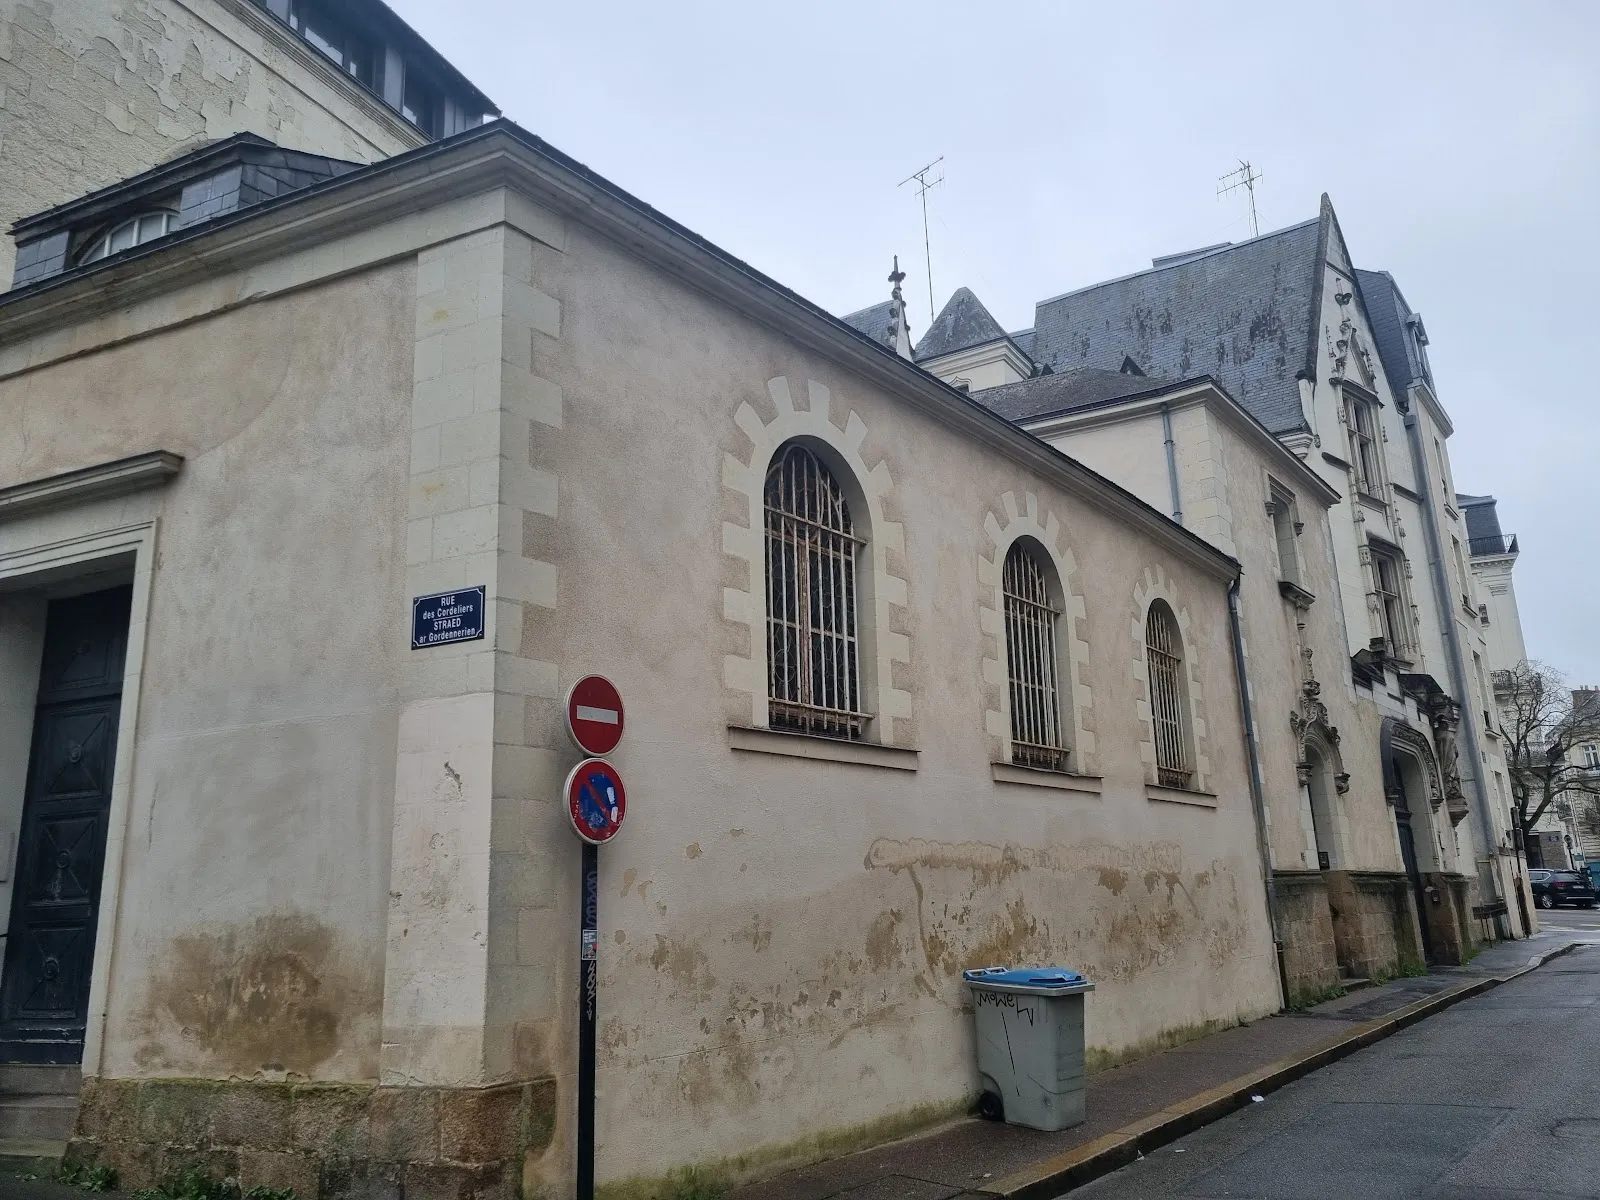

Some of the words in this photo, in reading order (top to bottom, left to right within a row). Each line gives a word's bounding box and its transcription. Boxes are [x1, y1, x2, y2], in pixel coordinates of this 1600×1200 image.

[441, 595, 455, 606] RUE
[423, 611, 435, 620] des
[437, 604, 474, 617] Cordeliers
[433, 618, 461, 631] STRAED
[419, 636, 427, 644] ar
[428, 627, 476, 642] Gordennerien
